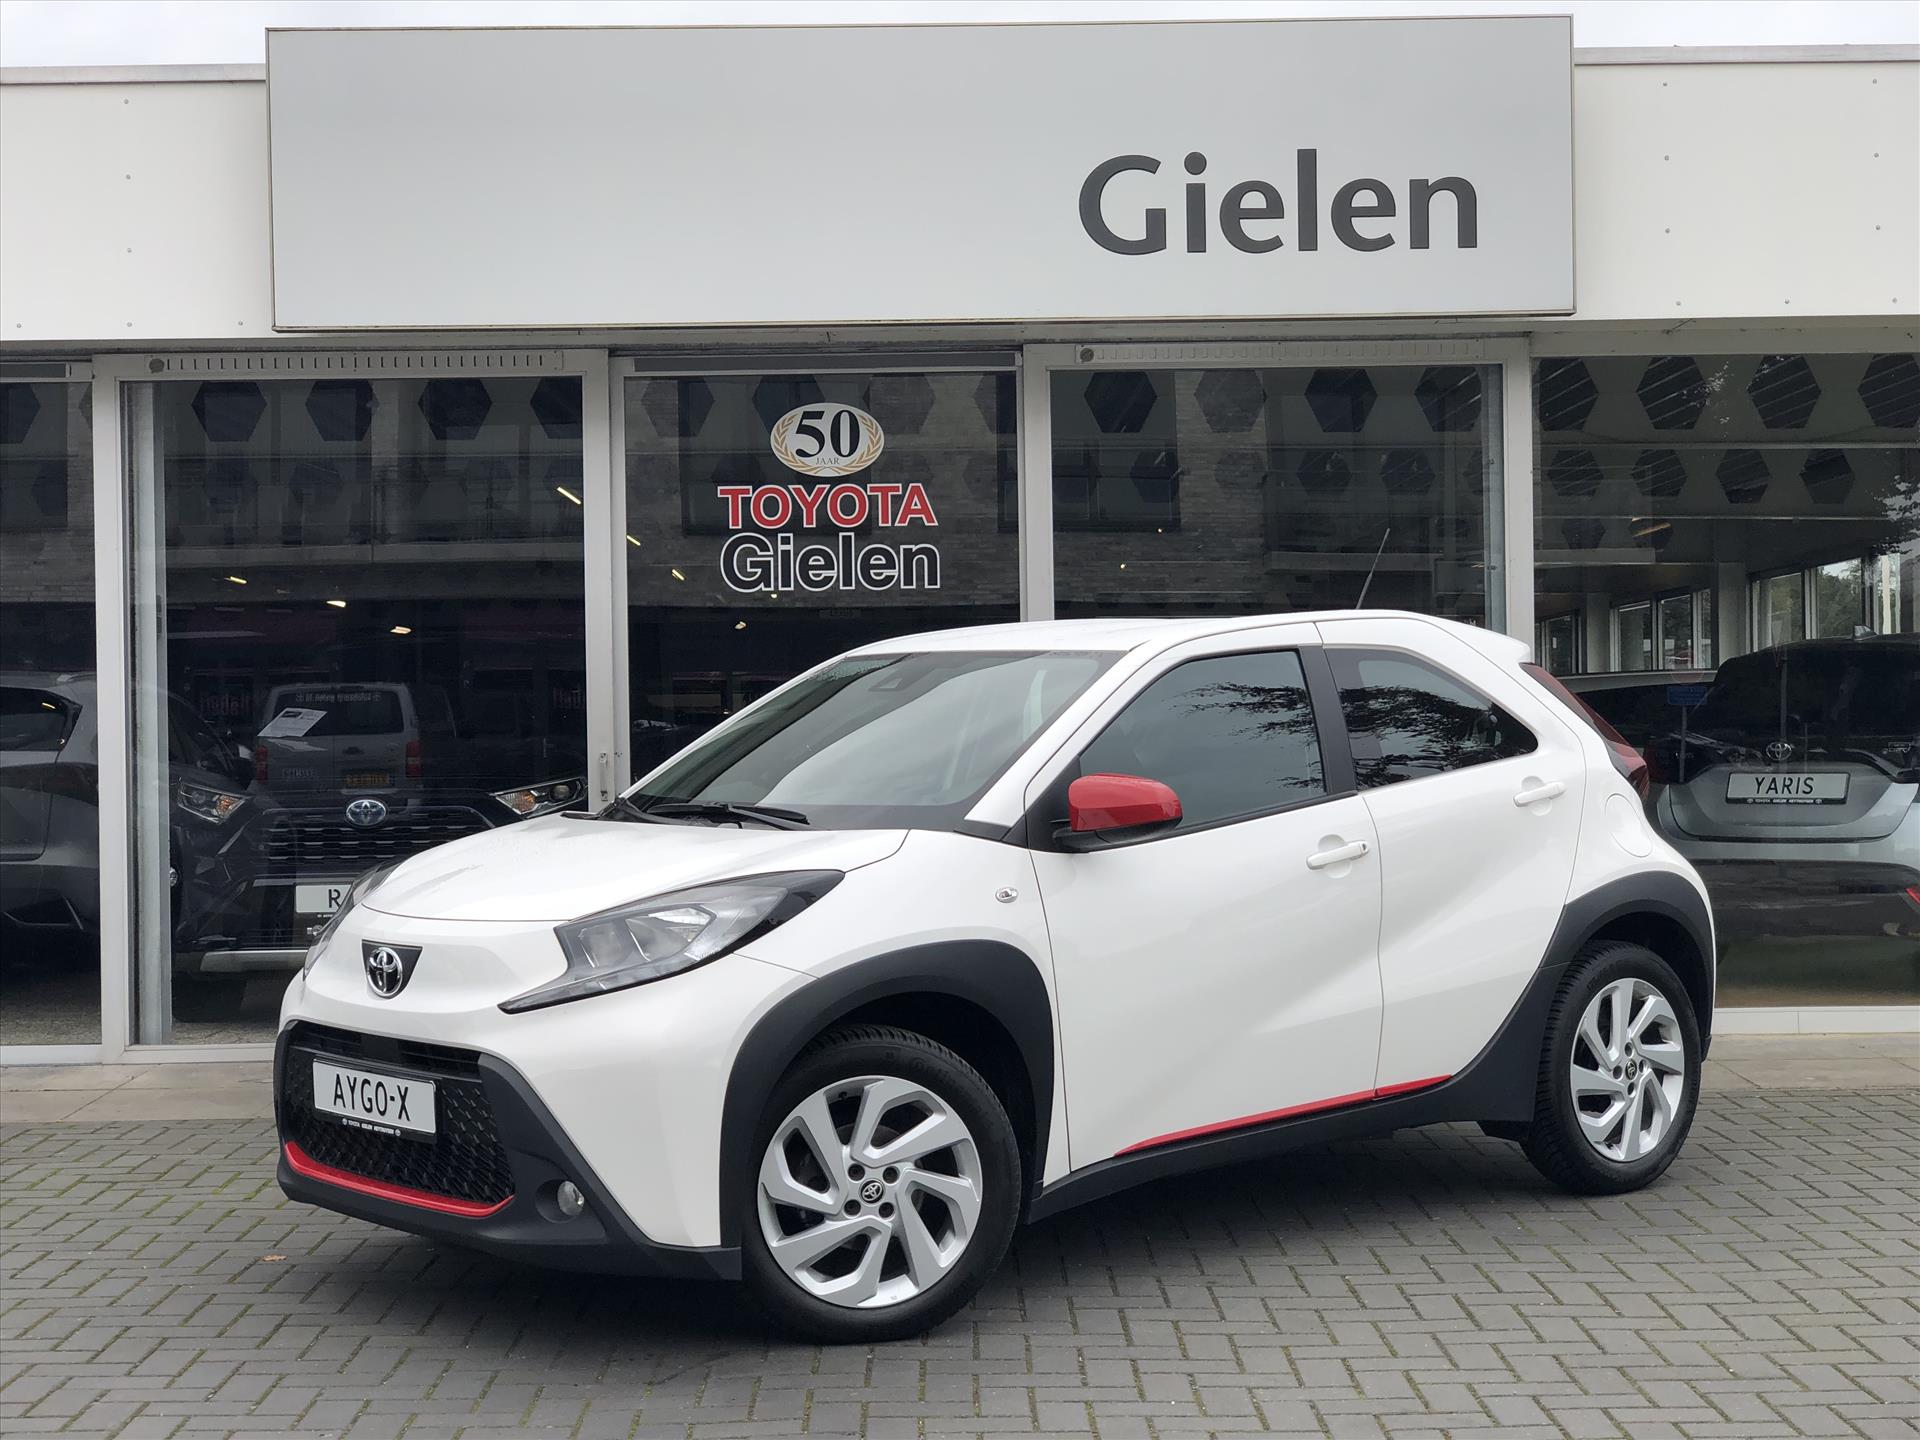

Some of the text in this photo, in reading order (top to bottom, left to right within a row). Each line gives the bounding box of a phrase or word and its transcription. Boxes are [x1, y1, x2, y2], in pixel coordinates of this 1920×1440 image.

[1078, 148, 1478, 256] Gielen
[794, 409, 861, 459] 50
[815, 456, 840, 466] JAAR
[717, 482, 939, 529] TOYOTA
[719, 532, 941, 593] Gielen
[1755, 776, 1815, 795] YARIS
[333, 1073, 411, 1122] AYGO-X
